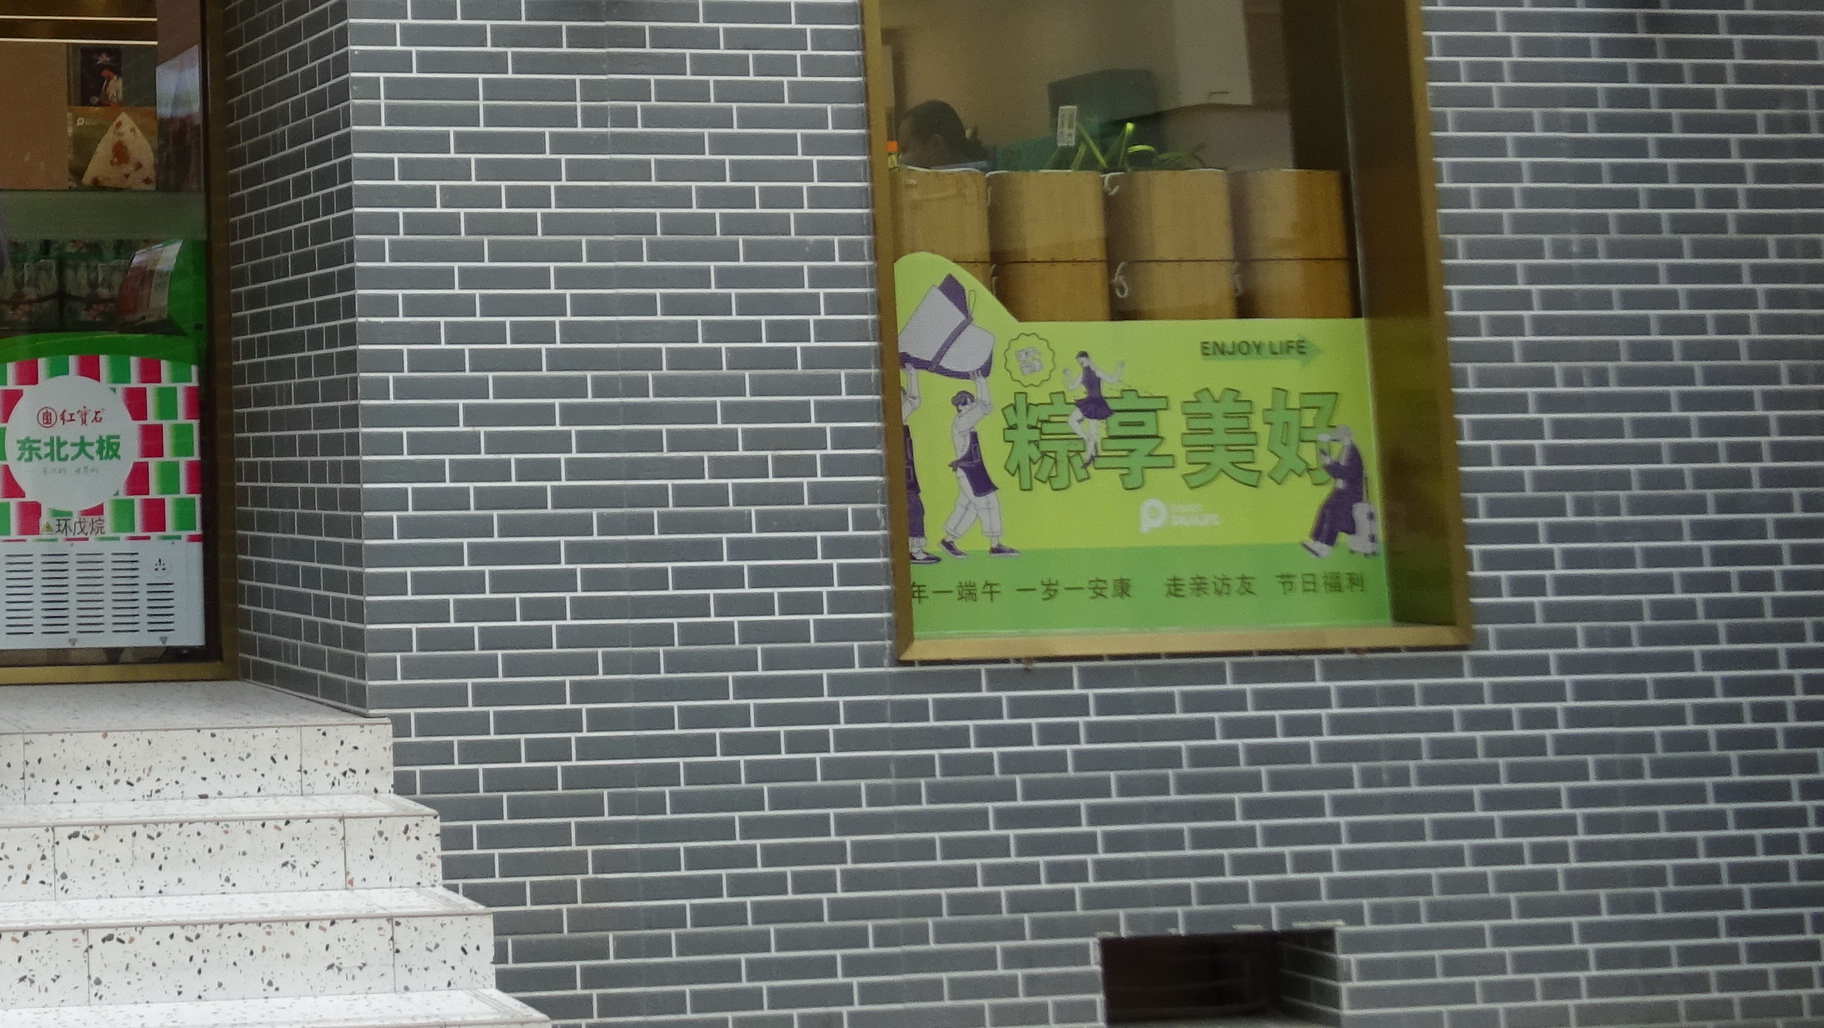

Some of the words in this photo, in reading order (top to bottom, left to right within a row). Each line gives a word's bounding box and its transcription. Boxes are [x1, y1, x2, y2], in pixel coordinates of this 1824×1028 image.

[1200, 340, 1262, 357] ENJOY
[1268, 338, 1308, 356] LIFE
[16, 434, 122, 463] 东北大板
[1002, 387, 1340, 491] 粽享美好
[55, 517, 106, 536] 环戊烷
[912, 579, 1002, 604] 年一端午
[1016, 577, 1132, 602] 一岁一安康
[1164, 574, 1257, 598] 走亲访友
[1276, 572, 1366, 596] 节日福利
